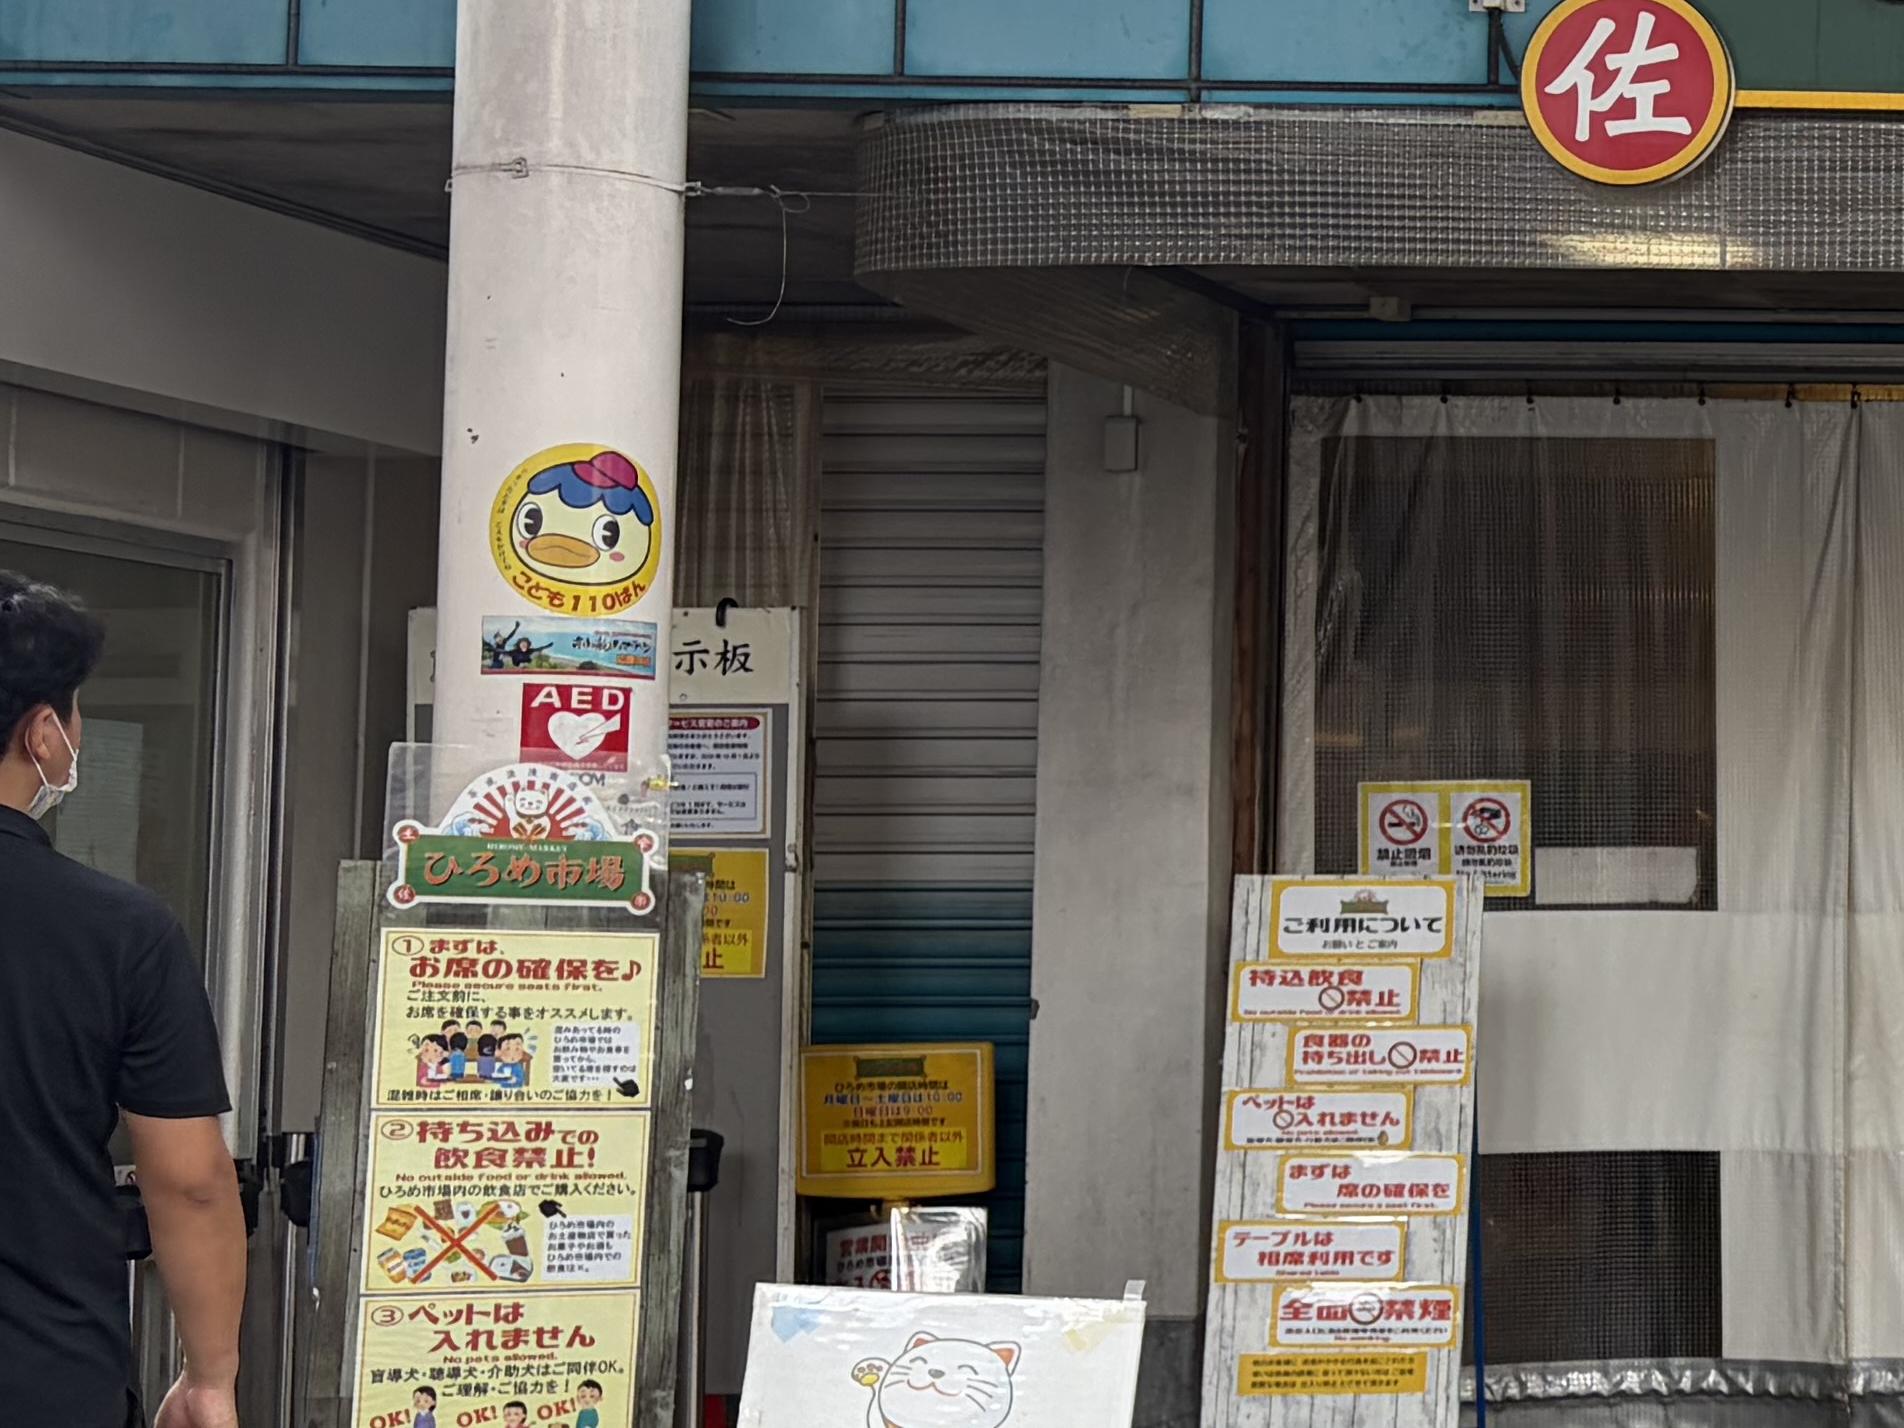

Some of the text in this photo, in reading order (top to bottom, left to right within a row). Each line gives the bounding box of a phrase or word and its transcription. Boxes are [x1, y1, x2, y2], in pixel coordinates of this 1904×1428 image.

[1544, 10, 1693, 144] 佐
[511, 571, 647, 613] こども110ばん
[530, 686, 625, 711] AED
[422, 850, 626, 892] ひろめ市場
[1283, 916, 1444, 934] ご利用について
[1248, 968, 1365, 988] 持込飲食
[1345, 988, 1401, 1008] 禁止
[1302, 1033, 1372, 1049] 食器の
[1301, 1049, 1387, 1067] 持ち出し
[1418, 1048, 1466, 1065] 禁止
[1241, 1095, 1316, 1110] ペットは
[1294, 1110, 1401, 1129] 入れません
[846, 1145, 941, 1169] 立入禁止
[1288, 1163, 1353, 1180] まずは
[1336, 1182, 1451, 1199] 席の確保を
[1232, 1230, 1334, 1248] テーブルは
[1256, 1249, 1396, 1268] 相席利用です
[1382, 1298, 1453, 1322] 禁煙
[427, 1324, 597, 1354] 入れません
[456, 1405, 498, 1428] OK!
[536, 1396, 578, 1421] OK!
